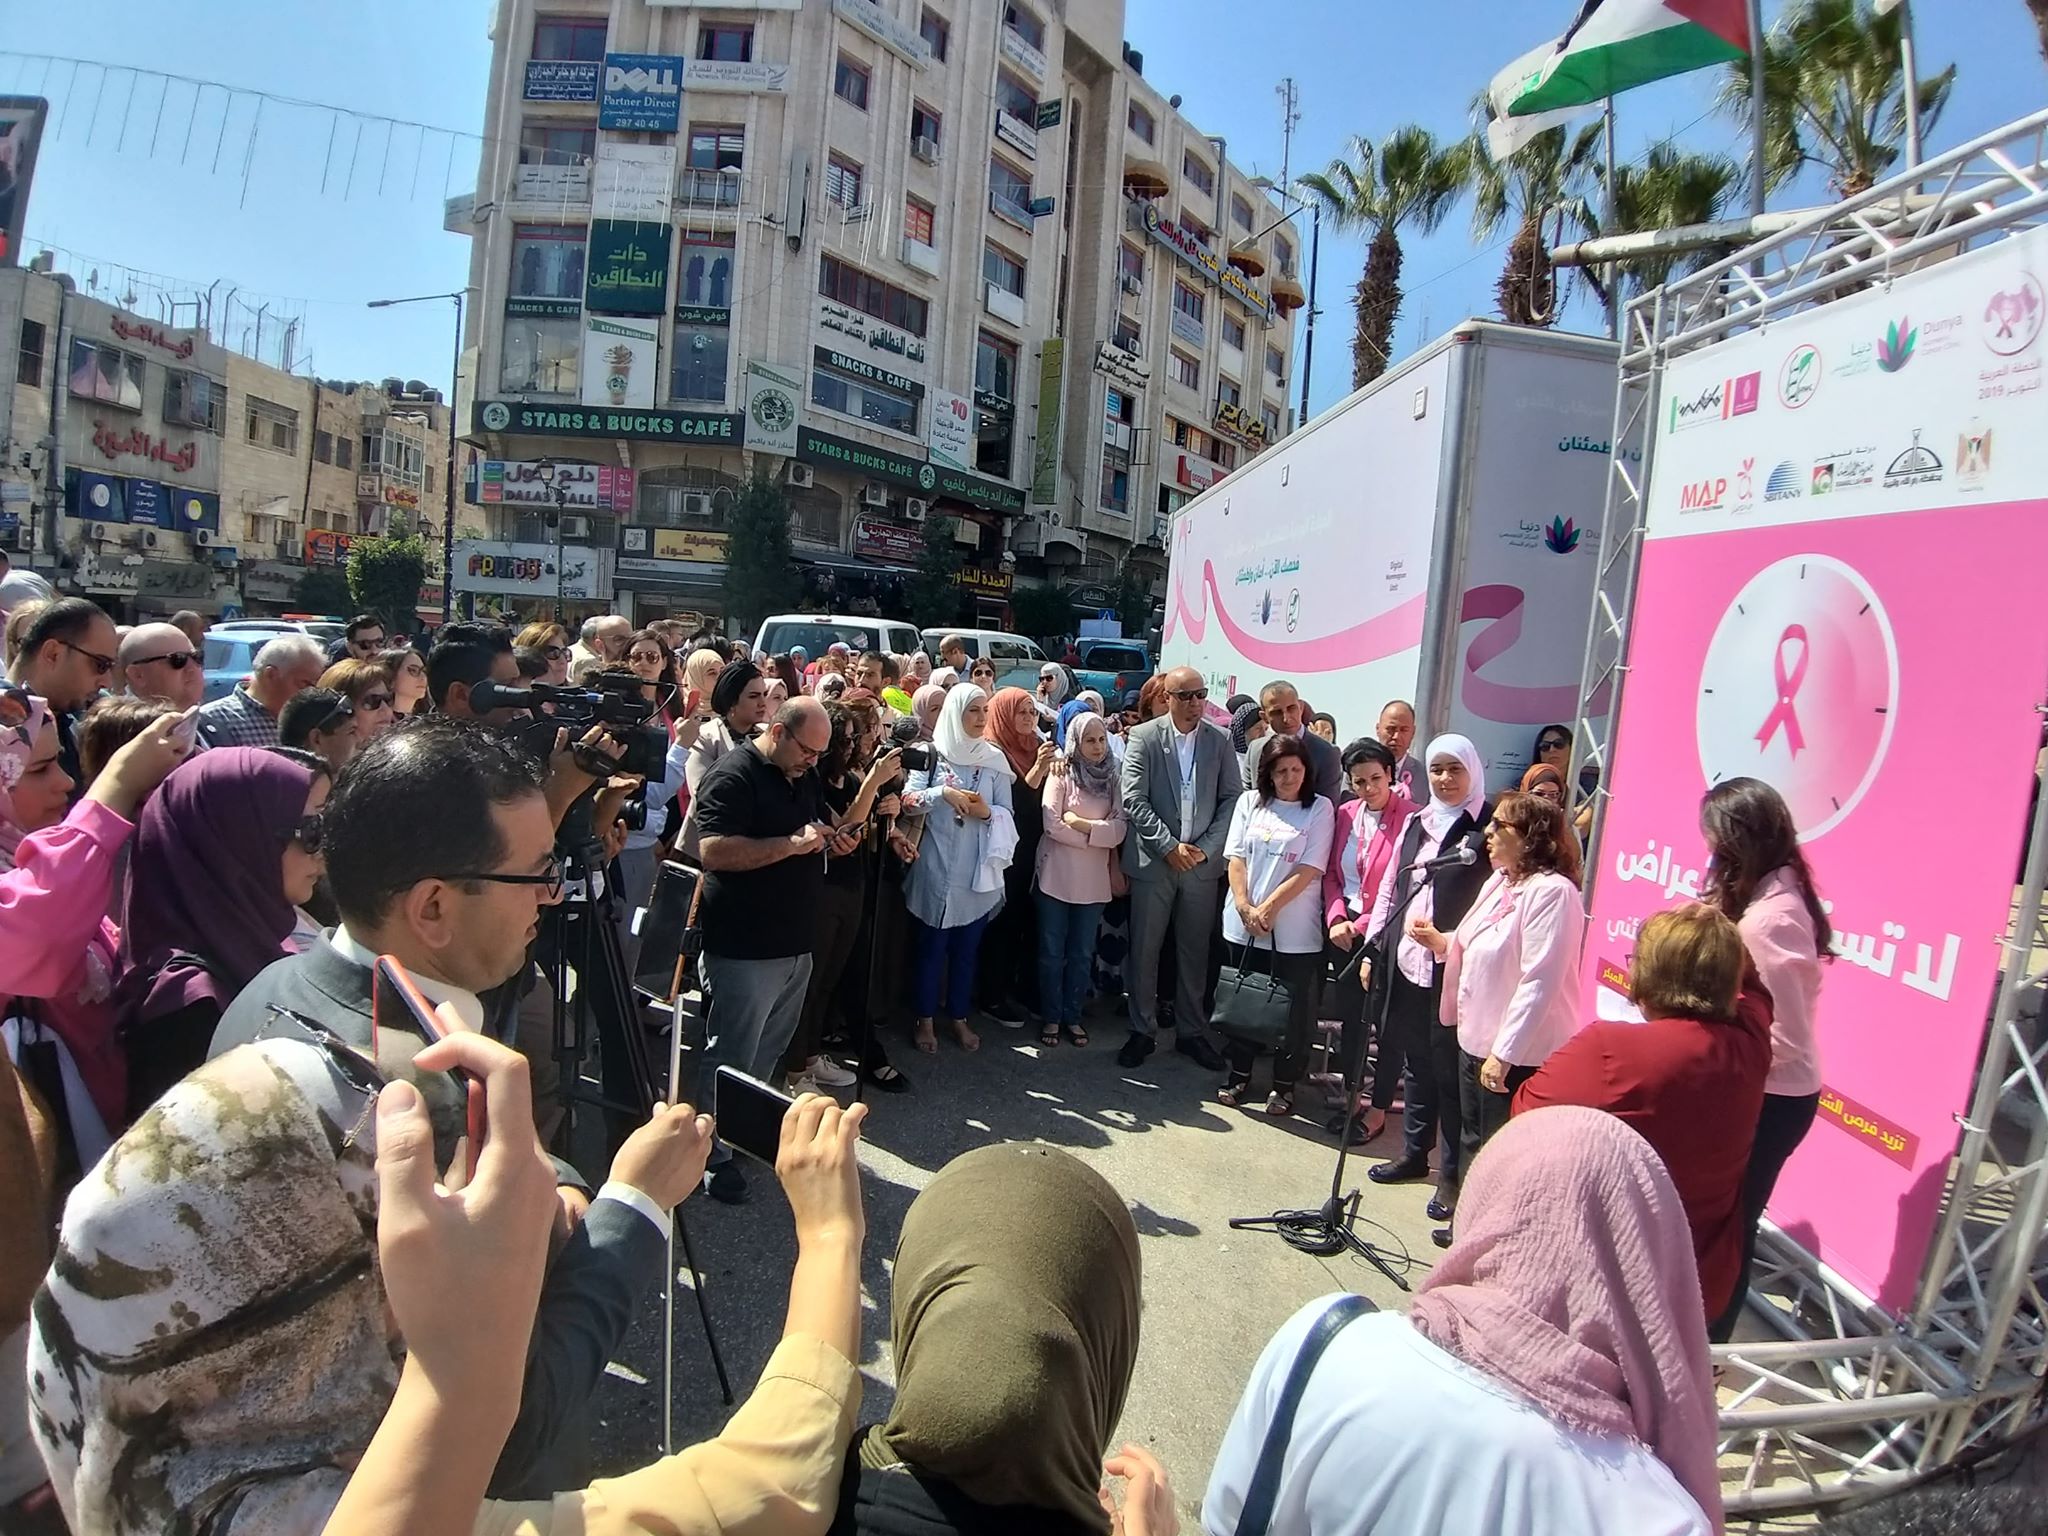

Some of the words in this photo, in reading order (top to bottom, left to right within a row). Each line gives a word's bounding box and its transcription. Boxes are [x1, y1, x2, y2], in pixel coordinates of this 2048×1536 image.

[605, 67, 678, 94] DELL
[604, 95, 640, 107] Partner
[643, 96, 676, 108] Direct
[616, 119, 632, 128] 297
[634, 119, 645, 128] 40
[1158, 219, 1174, 239] الله
[607, 243, 647, 262] ذات
[588, 268, 663, 288] النطاقين
[509, 304, 544, 313] SNACKS
[547, 304, 553, 313] &
[679, 310, 701, 320] شوب
[703, 311, 727, 323] كوفي
[1923, 315, 1963, 335] Dunya
[869, 327, 906, 356] النطاقين
[906, 343, 925, 363] ذات
[831, 353, 873, 377] SNACKS
[876, 371, 883, 381] &
[886, 374, 912, 392] CAFE
[1978, 385, 2005, 400] 2019
[951, 398, 968, 421] 10
[521, 410, 585, 430] STARS
[588, 415, 601, 430] &
[607, 414, 674, 434] BUCKS
[681, 417, 732, 437] CAFÉ
[807, 439, 842, 459] STARS
[843, 450, 851, 461] &
[853, 452, 886, 471] BUCKS
[888, 461, 913, 477] CAFÉ
[1681, 478, 1727, 509] MAP
[1519, 519, 1541, 533] دنيا
[1902, 932, 1962, 1002] لا
[1818, 1092, 1844, 1116] الش
[1843, 1114, 1878, 1137] فرص
[1879, 1132, 1907, 1152] تزيد
